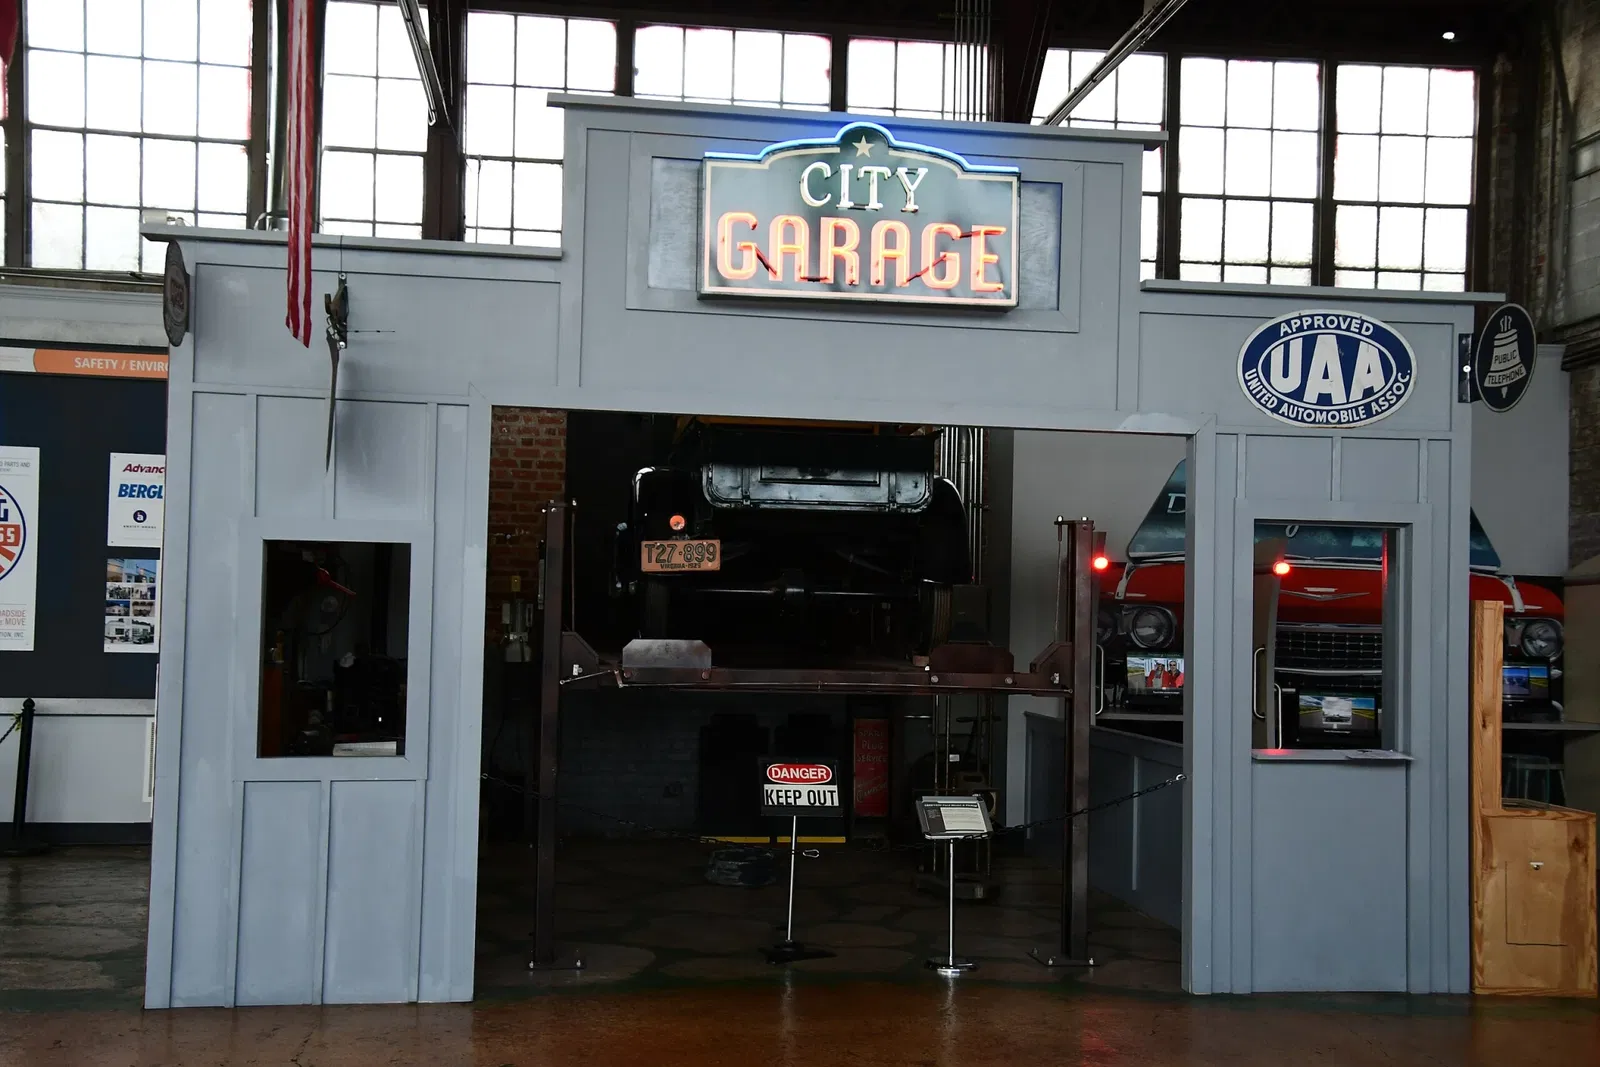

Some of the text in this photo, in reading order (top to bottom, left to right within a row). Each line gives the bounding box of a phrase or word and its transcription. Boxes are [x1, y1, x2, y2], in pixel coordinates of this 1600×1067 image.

[800, 161, 928, 212] CITY
[717, 212, 1007, 292] GARAGE
[1280, 315, 1374, 337] APPROVED
[74, 357, 119, 369] SAFETY
[1494, 349, 1518, 364] PUBLIC
[1270, 334, 1386, 405] UAA
[1487, 365, 1524, 385] TELEPHONE
[1244, 368, 1412, 424] UNITED AUTOMOBILE ASSOC.
[5, 617, 26, 626] MOVE
[856, 753, 888, 763] SERVICE
[771, 766, 828, 780] DANGER
[765, 789, 836, 806] KEEP OUT
